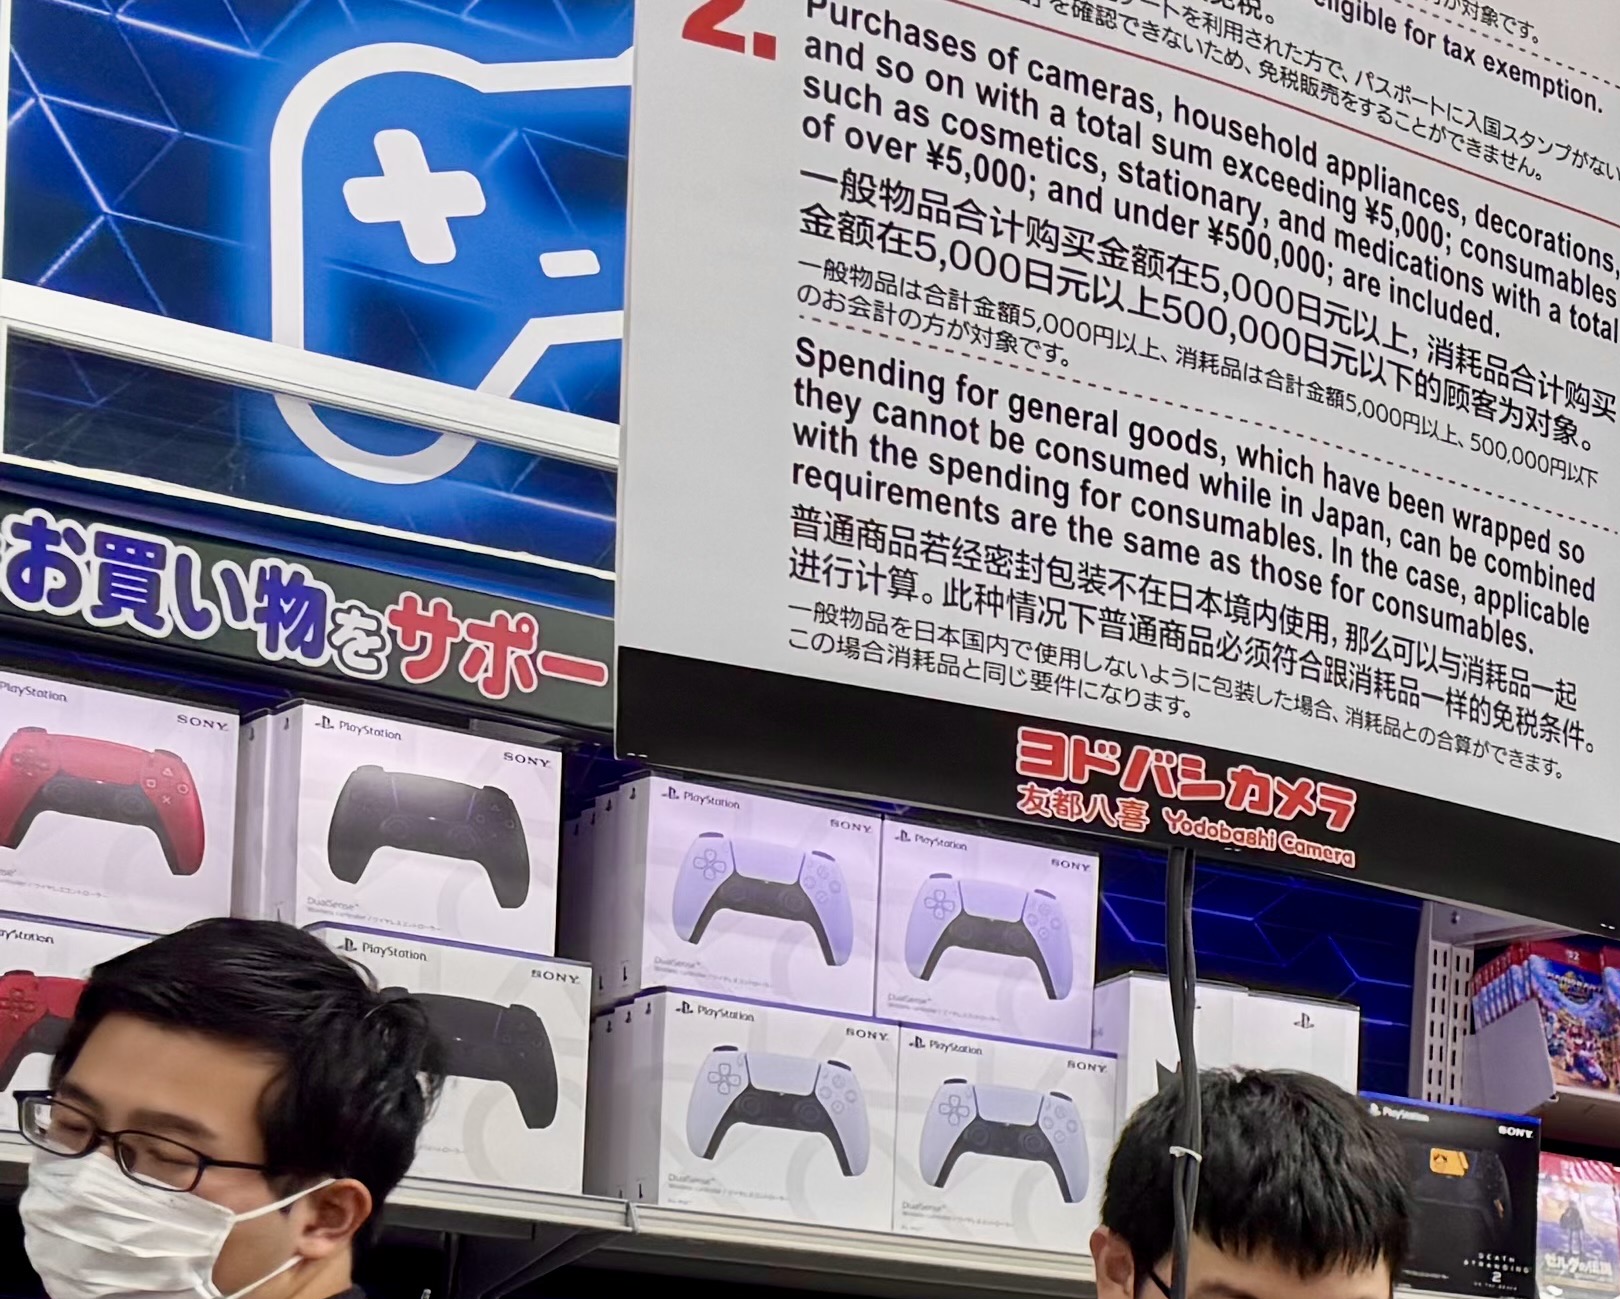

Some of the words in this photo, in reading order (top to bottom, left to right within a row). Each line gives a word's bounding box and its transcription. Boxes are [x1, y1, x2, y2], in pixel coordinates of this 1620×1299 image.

[801, 111, 836, 143] of
[844, 125, 918, 164] over
[925, 137, 1036, 202] ¥5,000;
[1046, 179, 1103, 214] and
[1113, 196, 1200, 240] under
[1207, 214, 1333, 287] ¥500,000;
[1341, 266, 1381, 298] are
[1388, 274, 1500, 339] included.
[802, 74, 882, 117] such
[892, 98, 930, 128] as
[940, 111, 1107, 183] cosmetics,
[1116, 159, 1269, 229] stationary,
[1277, 208, 1325, 243] and
[1333, 226, 1484, 298] medications
[1490, 281, 1541, 317] with
[1547, 301, 1561, 325] a
[1568, 303, 1619, 344] total
[804, 34, 864, 72] and
[875, 54, 914, 84] so
[924, 68, 964, 99] on
[974, 80, 1038, 121] with
[1048, 103, 1065, 129] a
[1075, 105, 1141, 150] total
[1151, 132, 1212, 170] sum
[1222, 153, 1356, 225] exceeding
[1364, 194, 1451, 256] ¥5,000;
[1459, 236, 1617, 308] consumables
[805, 0, 977, 63] Purchases
[986, 44, 1020, 75] of
[1026, 58, 1163, 123] cameras,
[1173, 93, 1317, 169] household
[1325, 152, 1466, 227] appliances,
[1474, 202, 1620, 281] decorations,
[796, 283, 1070, 369] のお会計の方が対象です。
[791, 419, 858, 458] with
[868, 432, 918, 470] the
[927, 451, 1069, 510] spending
[1079, 477, 1122, 513] for
[1130, 495, 1323, 560] consumables.
[1331, 535, 1353, 569] In
[1360, 546, 1398, 580] the
[1405, 564, 1466, 606] case,
[1473, 583, 1590, 635] applicable
[792, 376, 862, 425] they
[872, 400, 980, 446] cannot
[989, 418, 1025, 455] be
[1034, 436, 1189, 491] consumed
[1198, 470, 1272, 509] while
[1280, 484, 1303, 518] in
[1310, 495, 1391, 549] Japan,
[1399, 527, 1441, 558] can
[1448, 534, 1477, 568] be
[1483, 552, 1596, 603] combined
[794, 335, 945, 405] Spending
[955, 372, 999, 410] for
[1007, 392, 1118, 438] general
[1127, 420, 1226, 467] goods,
[1235, 442, 1314, 485] which
[1322, 460, 1380, 504] have
[1387, 480, 1444, 524] been
[1451, 506, 1551, 555] wrapped
[1557, 538, 1585, 564] so
[791, 461, 1000, 526] requirements
[1010, 507, 1058, 537] are
[1066, 513, 1114, 548] the
[1122, 530, 1200, 566] same
[1209, 548, 1241, 575] as
[1249, 552, 1322, 596] those
[1329, 571, 1366, 607] for
[1371, 590, 1534, 655] consumables.
[338, 718, 402, 742] PlayStation
[502, 751, 552, 769] SONY
[788, 627, 1191, 719] この場合消耗品と同じ要件になります。
[1016, 726, 1358, 833] ヨドバシカメラ
[1017, 782, 1151, 834] 友都八喜
[1162, 806, 1277, 851] Yodobashi
[1278, 830, 1357, 869] Camera
